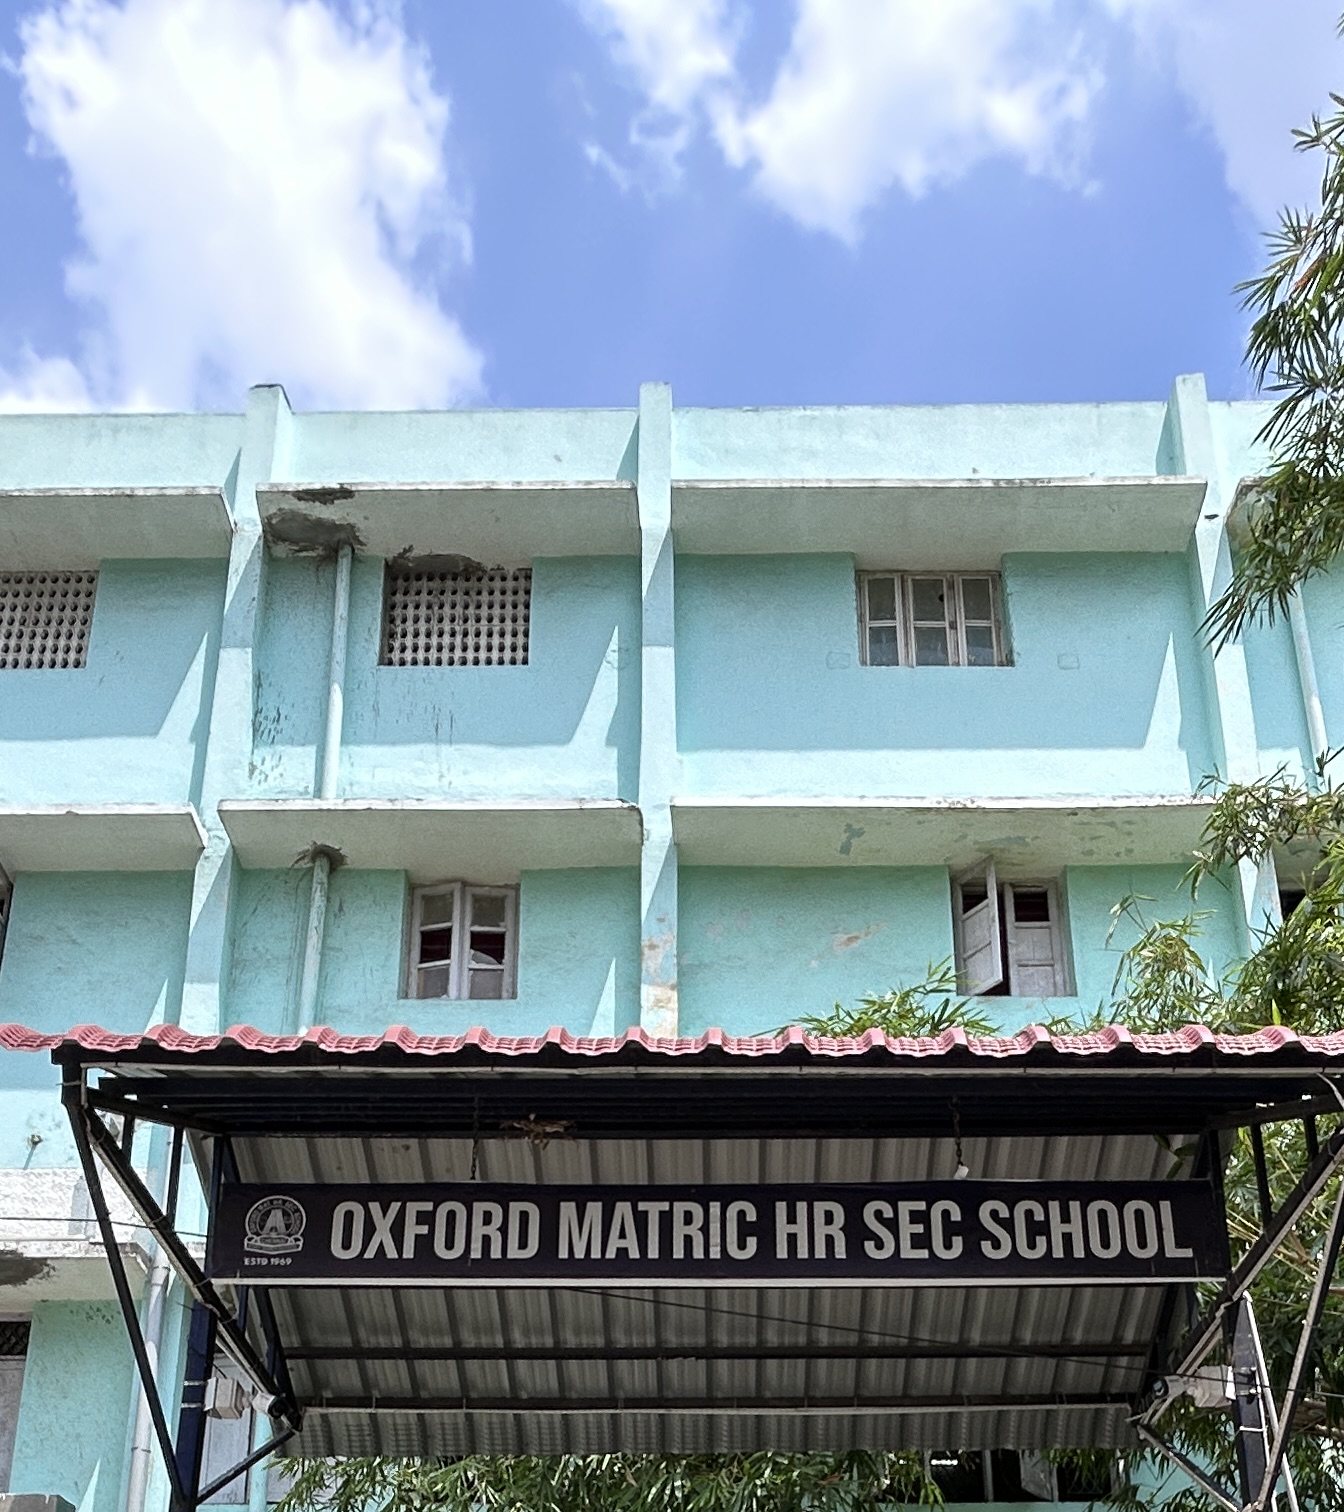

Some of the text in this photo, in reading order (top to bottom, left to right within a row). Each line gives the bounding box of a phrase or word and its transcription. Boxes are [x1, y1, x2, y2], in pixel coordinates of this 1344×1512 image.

[331, 1200, 540, 1260] OXFORD
[558, 1200, 758, 1260] MATRIC
[775, 1201, 847, 1260] HR
[863, 1200, 963, 1260] SEC
[978, 1199, 1194, 1260] SCHOOL
[243, 1257, 292, 1266] ESTD 1969
